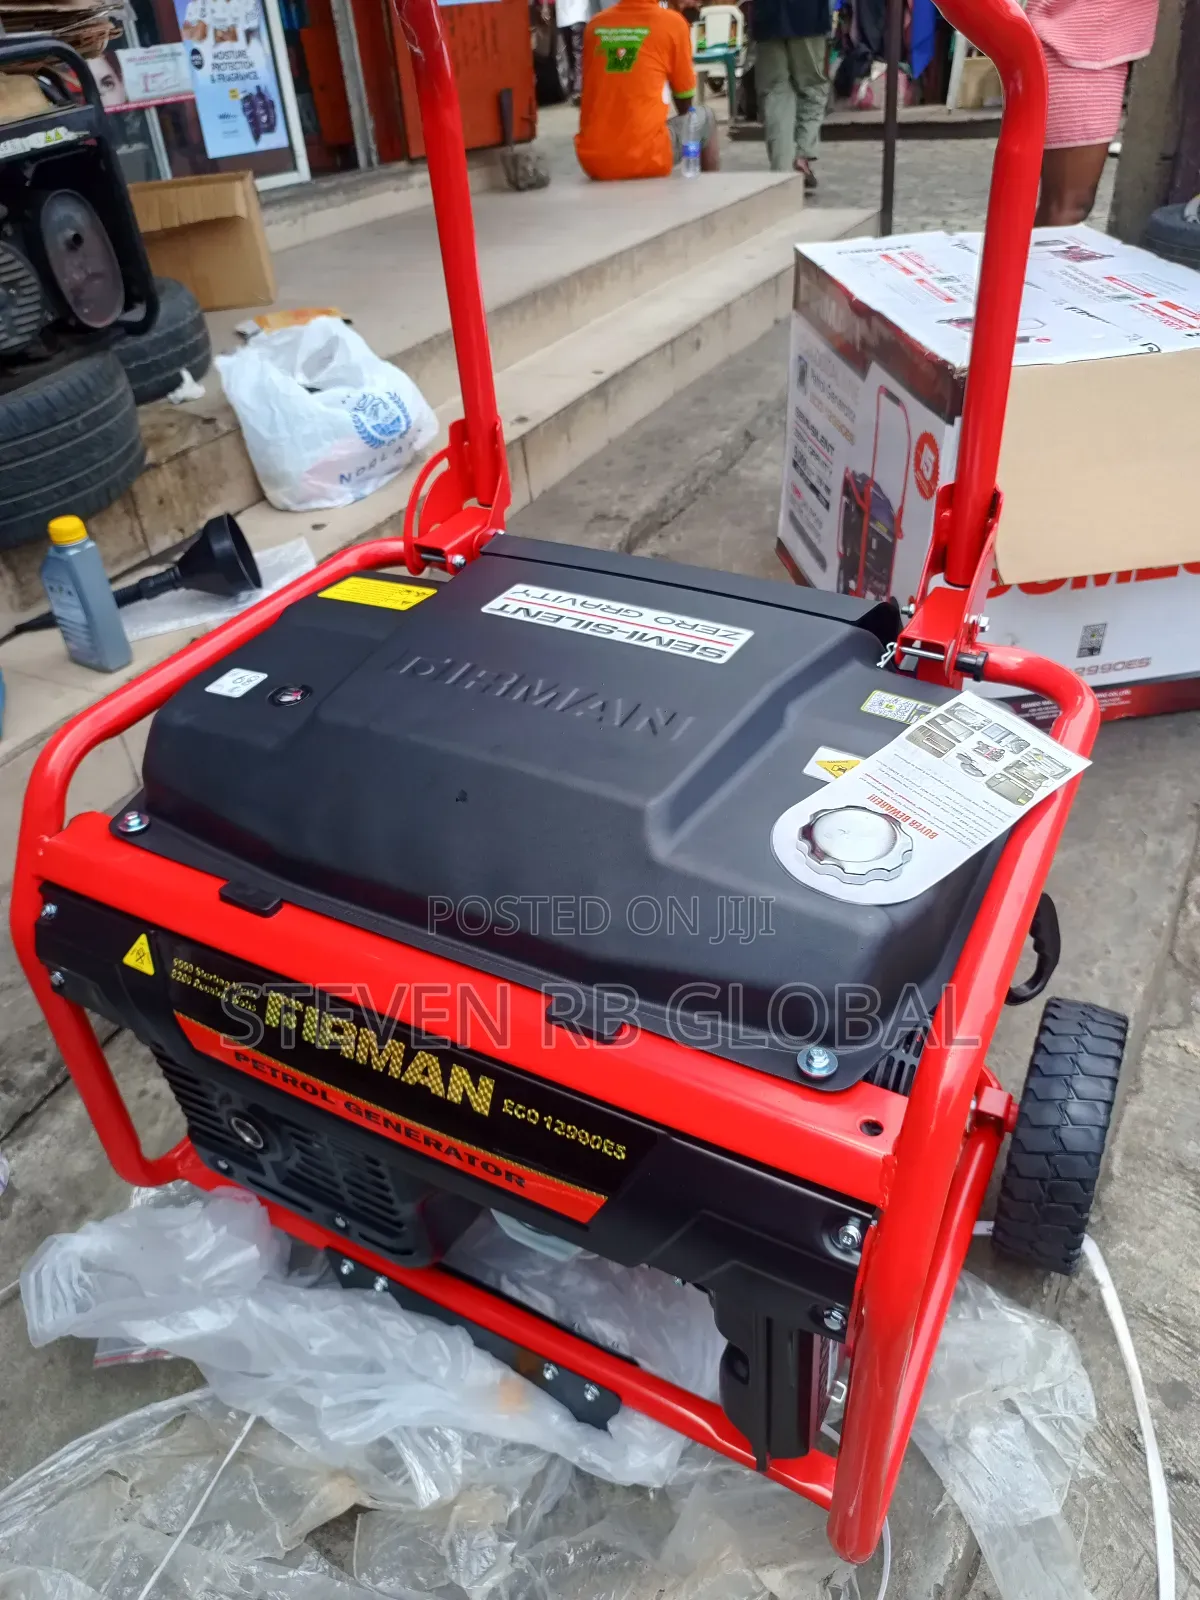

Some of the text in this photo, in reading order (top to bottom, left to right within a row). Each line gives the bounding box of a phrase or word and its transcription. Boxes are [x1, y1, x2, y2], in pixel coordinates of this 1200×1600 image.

[490, 603, 728, 660] SEMI-SILENT
[511, 588, 747, 641] ZERO GRAVITY
[866, 793, 939, 840] BUYER BEWARE!!!
[264, 990, 495, 1117] FIRMAN
[234, 1052, 527, 1189] PETROL GENERATOR
[502, 1098, 627, 1160] ECO 12990ES
